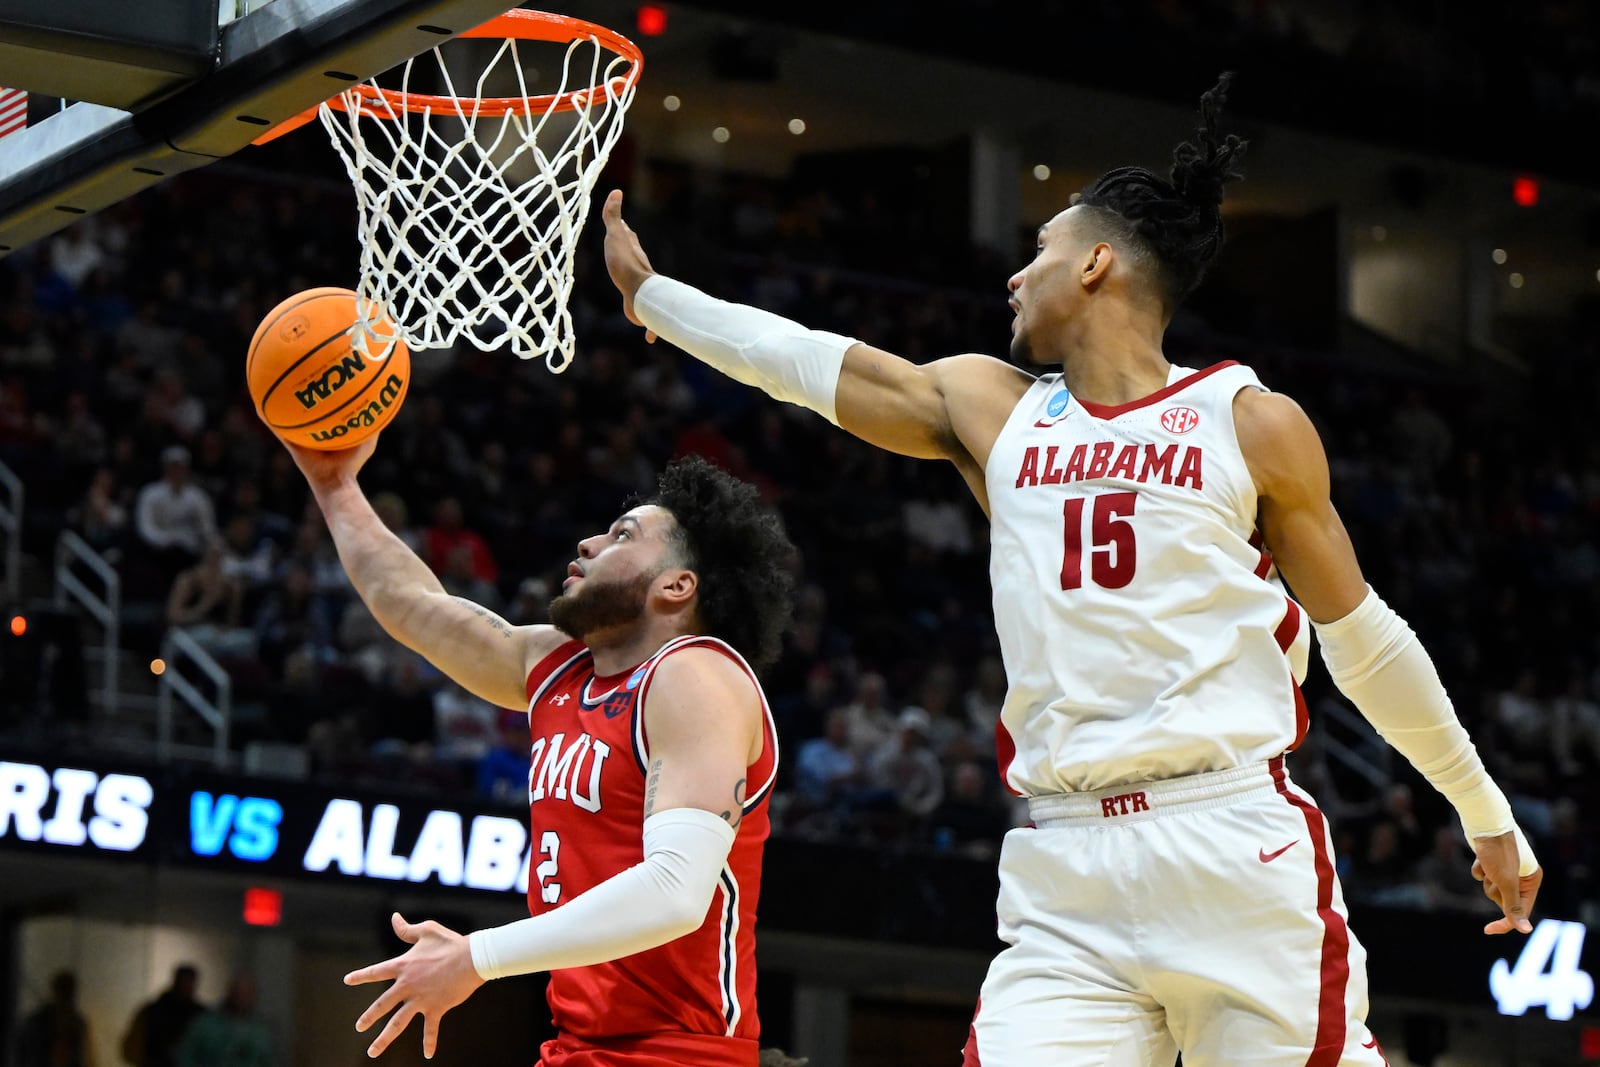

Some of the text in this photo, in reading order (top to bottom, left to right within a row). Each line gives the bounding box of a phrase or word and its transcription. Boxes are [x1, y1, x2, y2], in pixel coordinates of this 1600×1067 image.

[294, 350, 366, 409] NCAA
[311, 373, 403, 441] Wilson
[1161, 408, 1199, 433] SEC
[1015, 441, 1203, 491] ALABAMA
[1060, 492, 1138, 591] 15
[0, 761, 531, 894] RIS VS ALAB
[1101, 791, 1150, 818] RTR
[535, 830, 562, 904] 2
